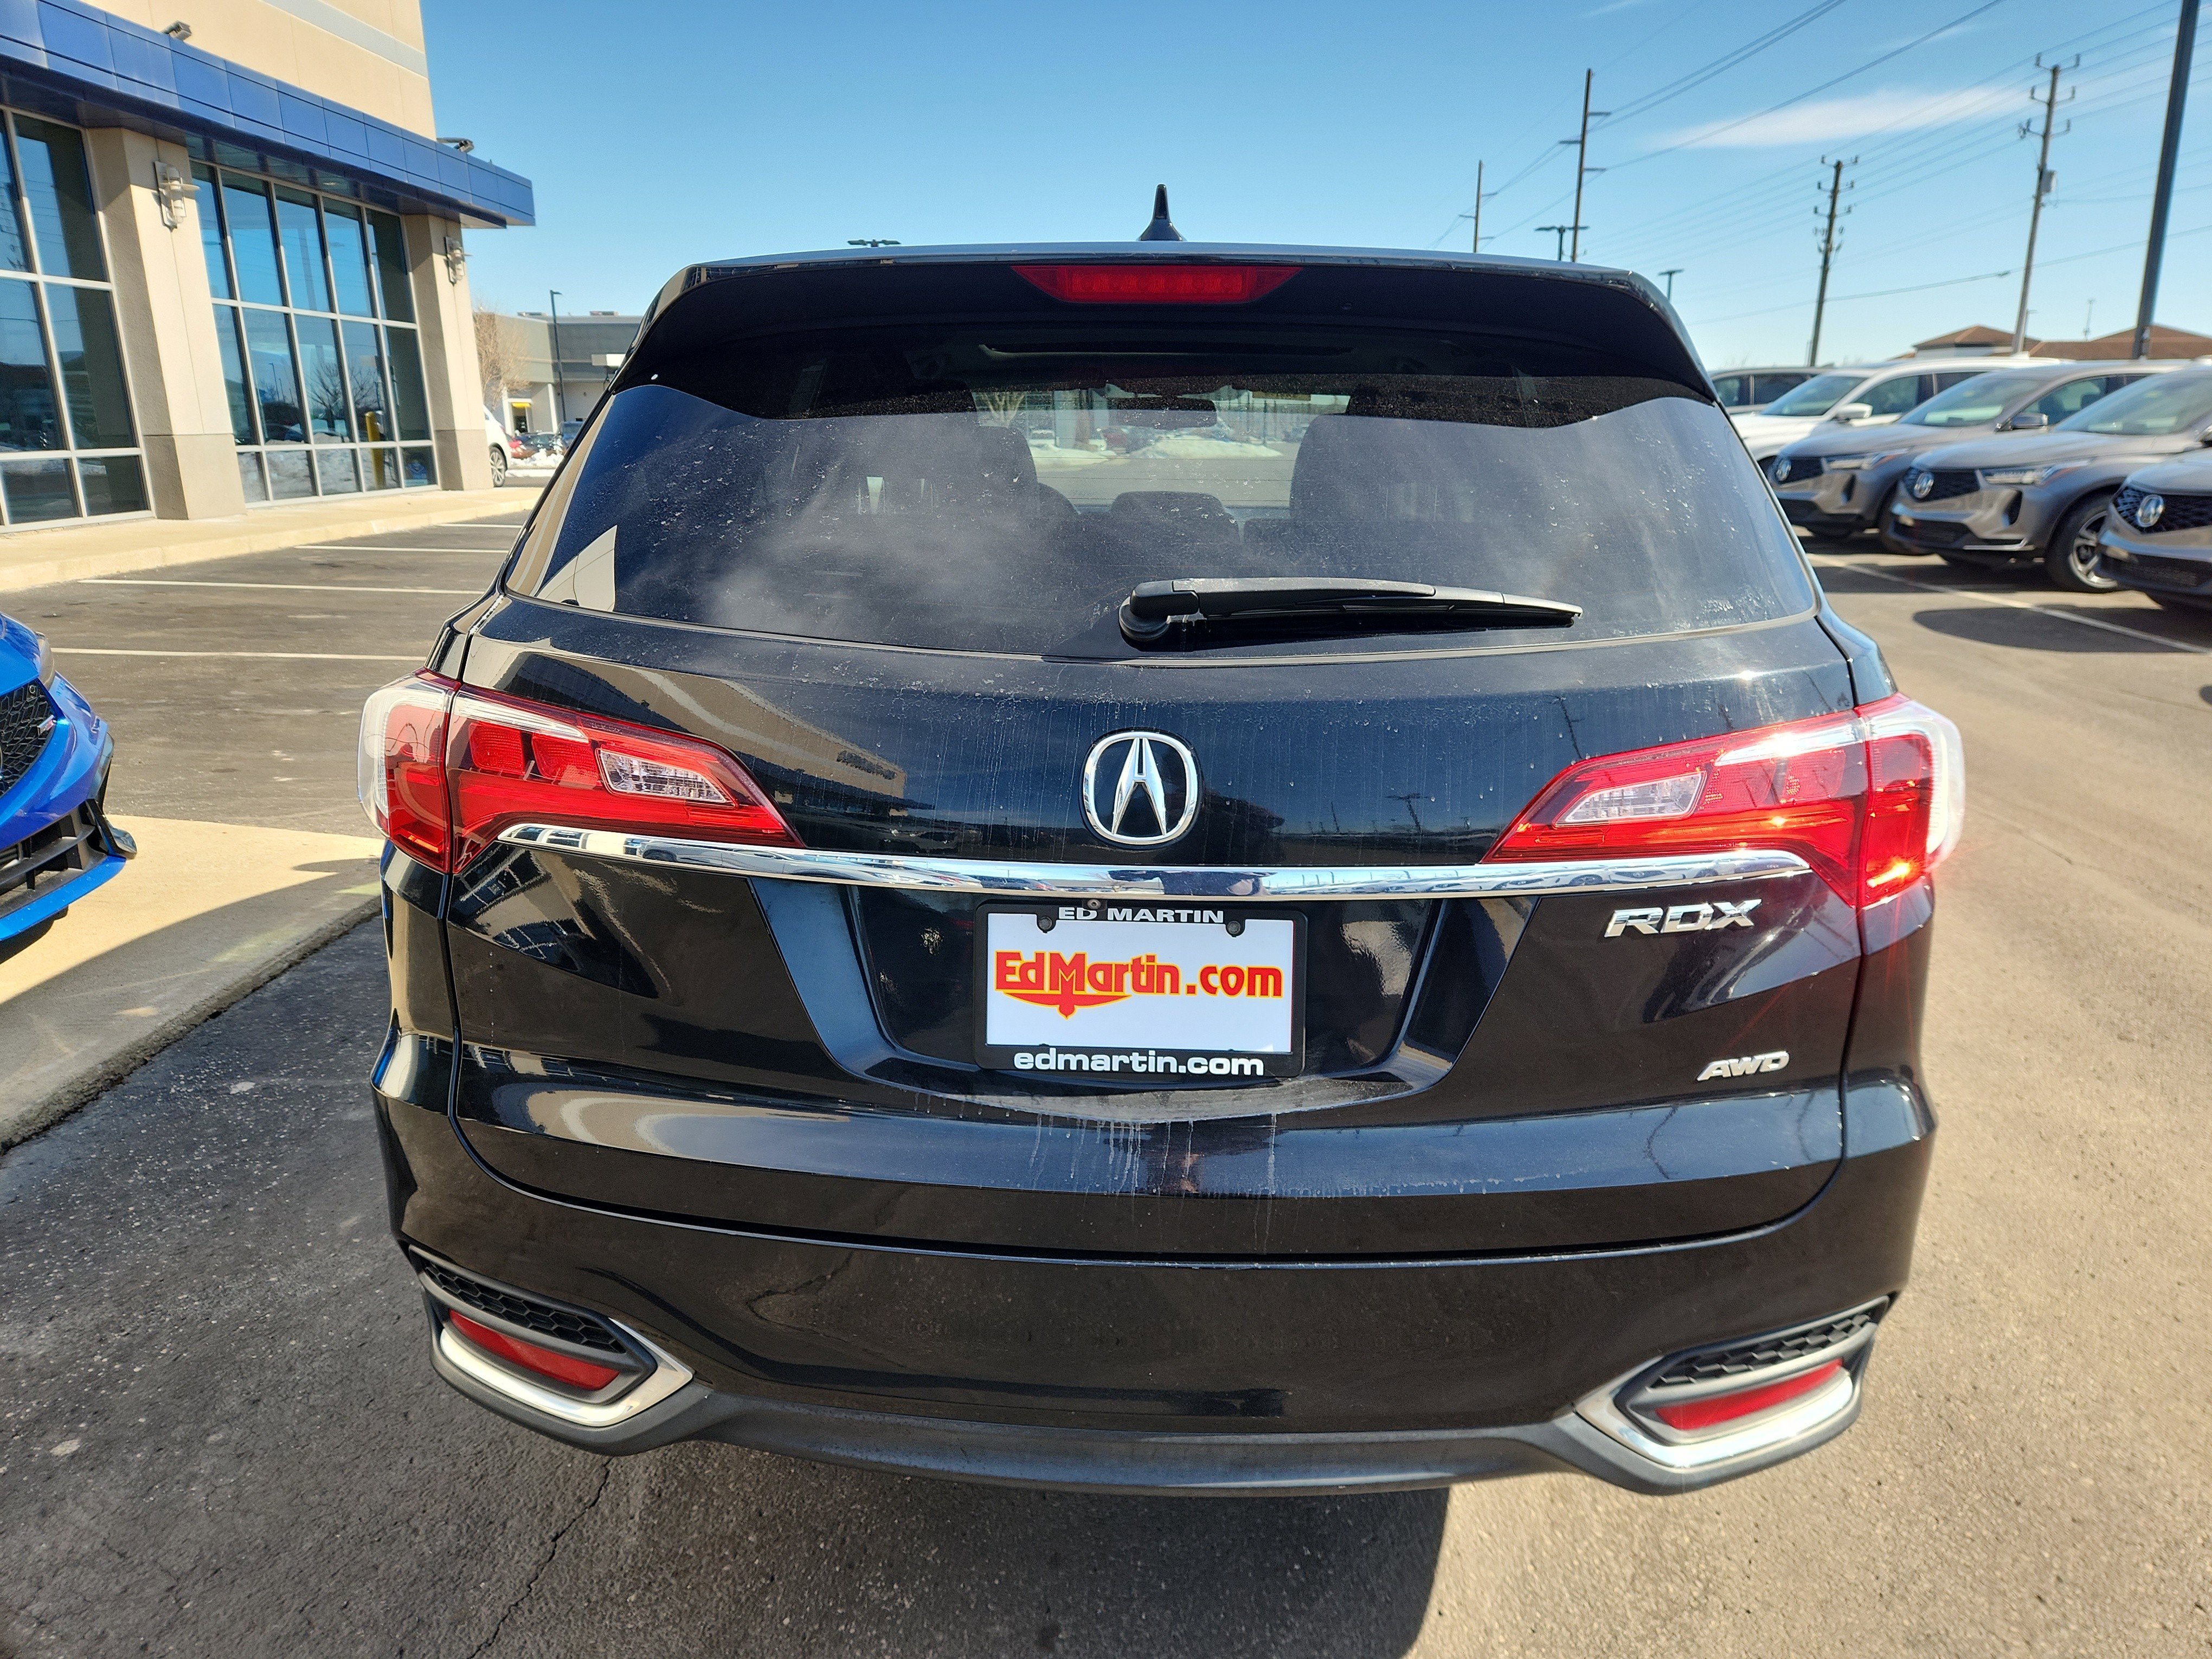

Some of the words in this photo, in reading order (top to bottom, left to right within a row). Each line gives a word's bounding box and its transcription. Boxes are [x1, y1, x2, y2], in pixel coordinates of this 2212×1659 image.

[1058, 906, 1097, 921] ED
[1107, 908, 1224, 923] MARTIN
[1604, 898, 1762, 938] RDX
[1013, 1047, 1264, 1076] edmartin.com
[1696, 1050, 1790, 1082] AWD
